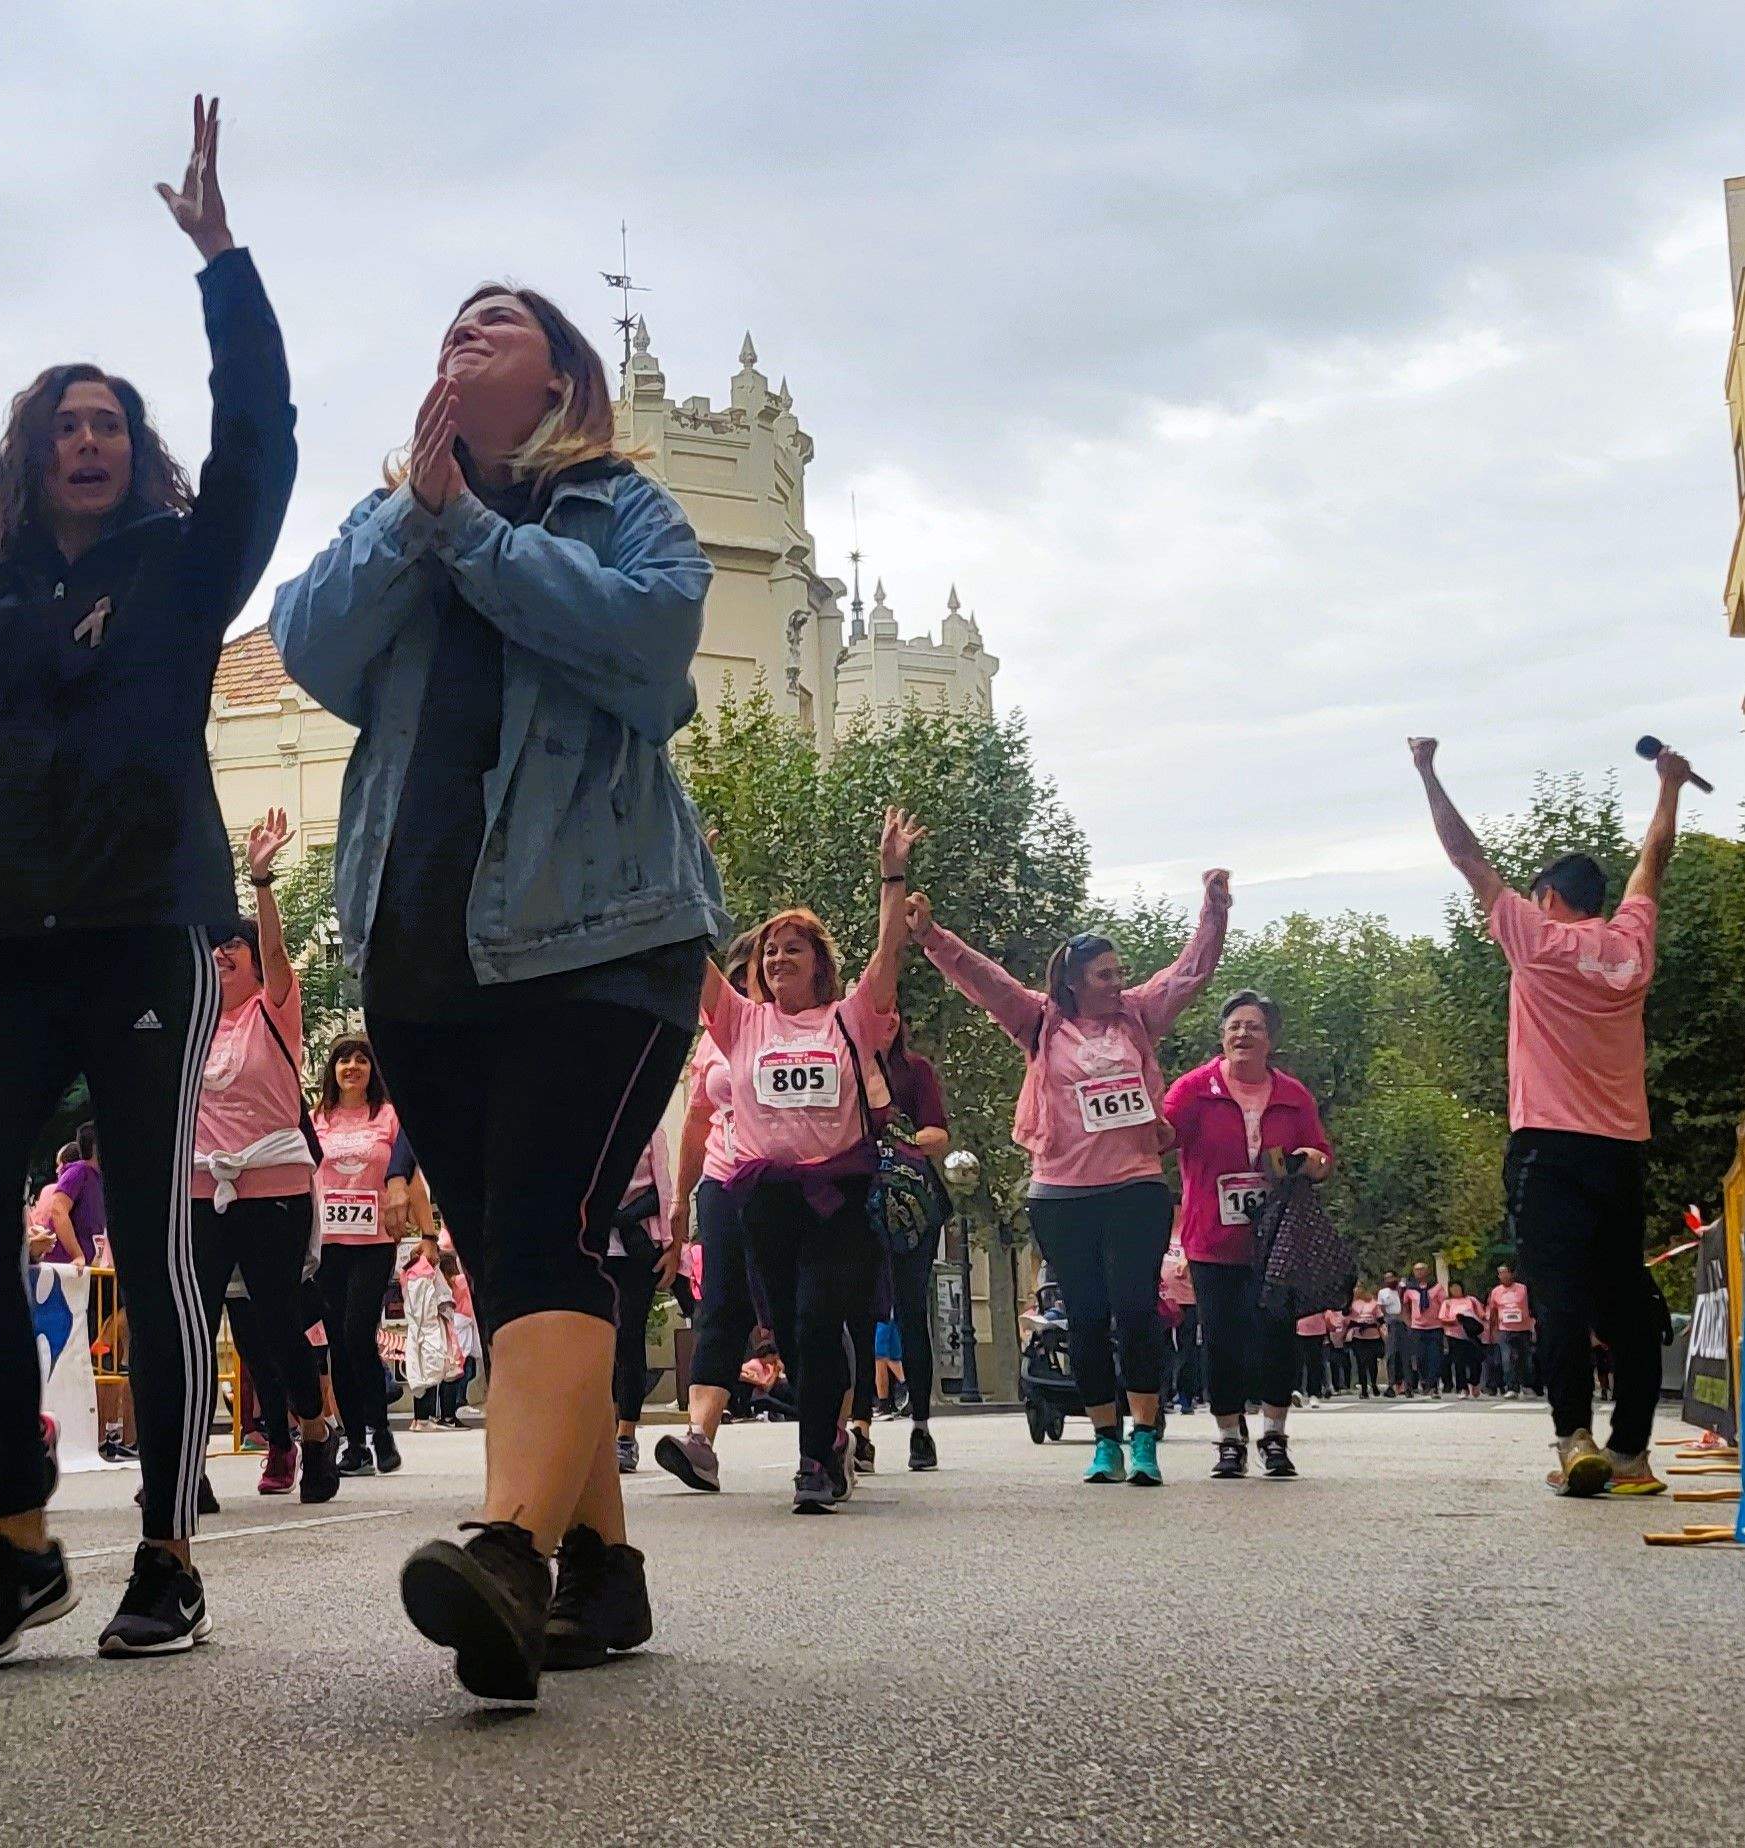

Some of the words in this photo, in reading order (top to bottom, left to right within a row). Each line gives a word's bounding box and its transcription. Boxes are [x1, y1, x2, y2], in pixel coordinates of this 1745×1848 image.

[772, 1066, 825, 1092] 805
[1088, 1090, 1145, 1117] 1615
[325, 1205, 374, 1223] 3874
